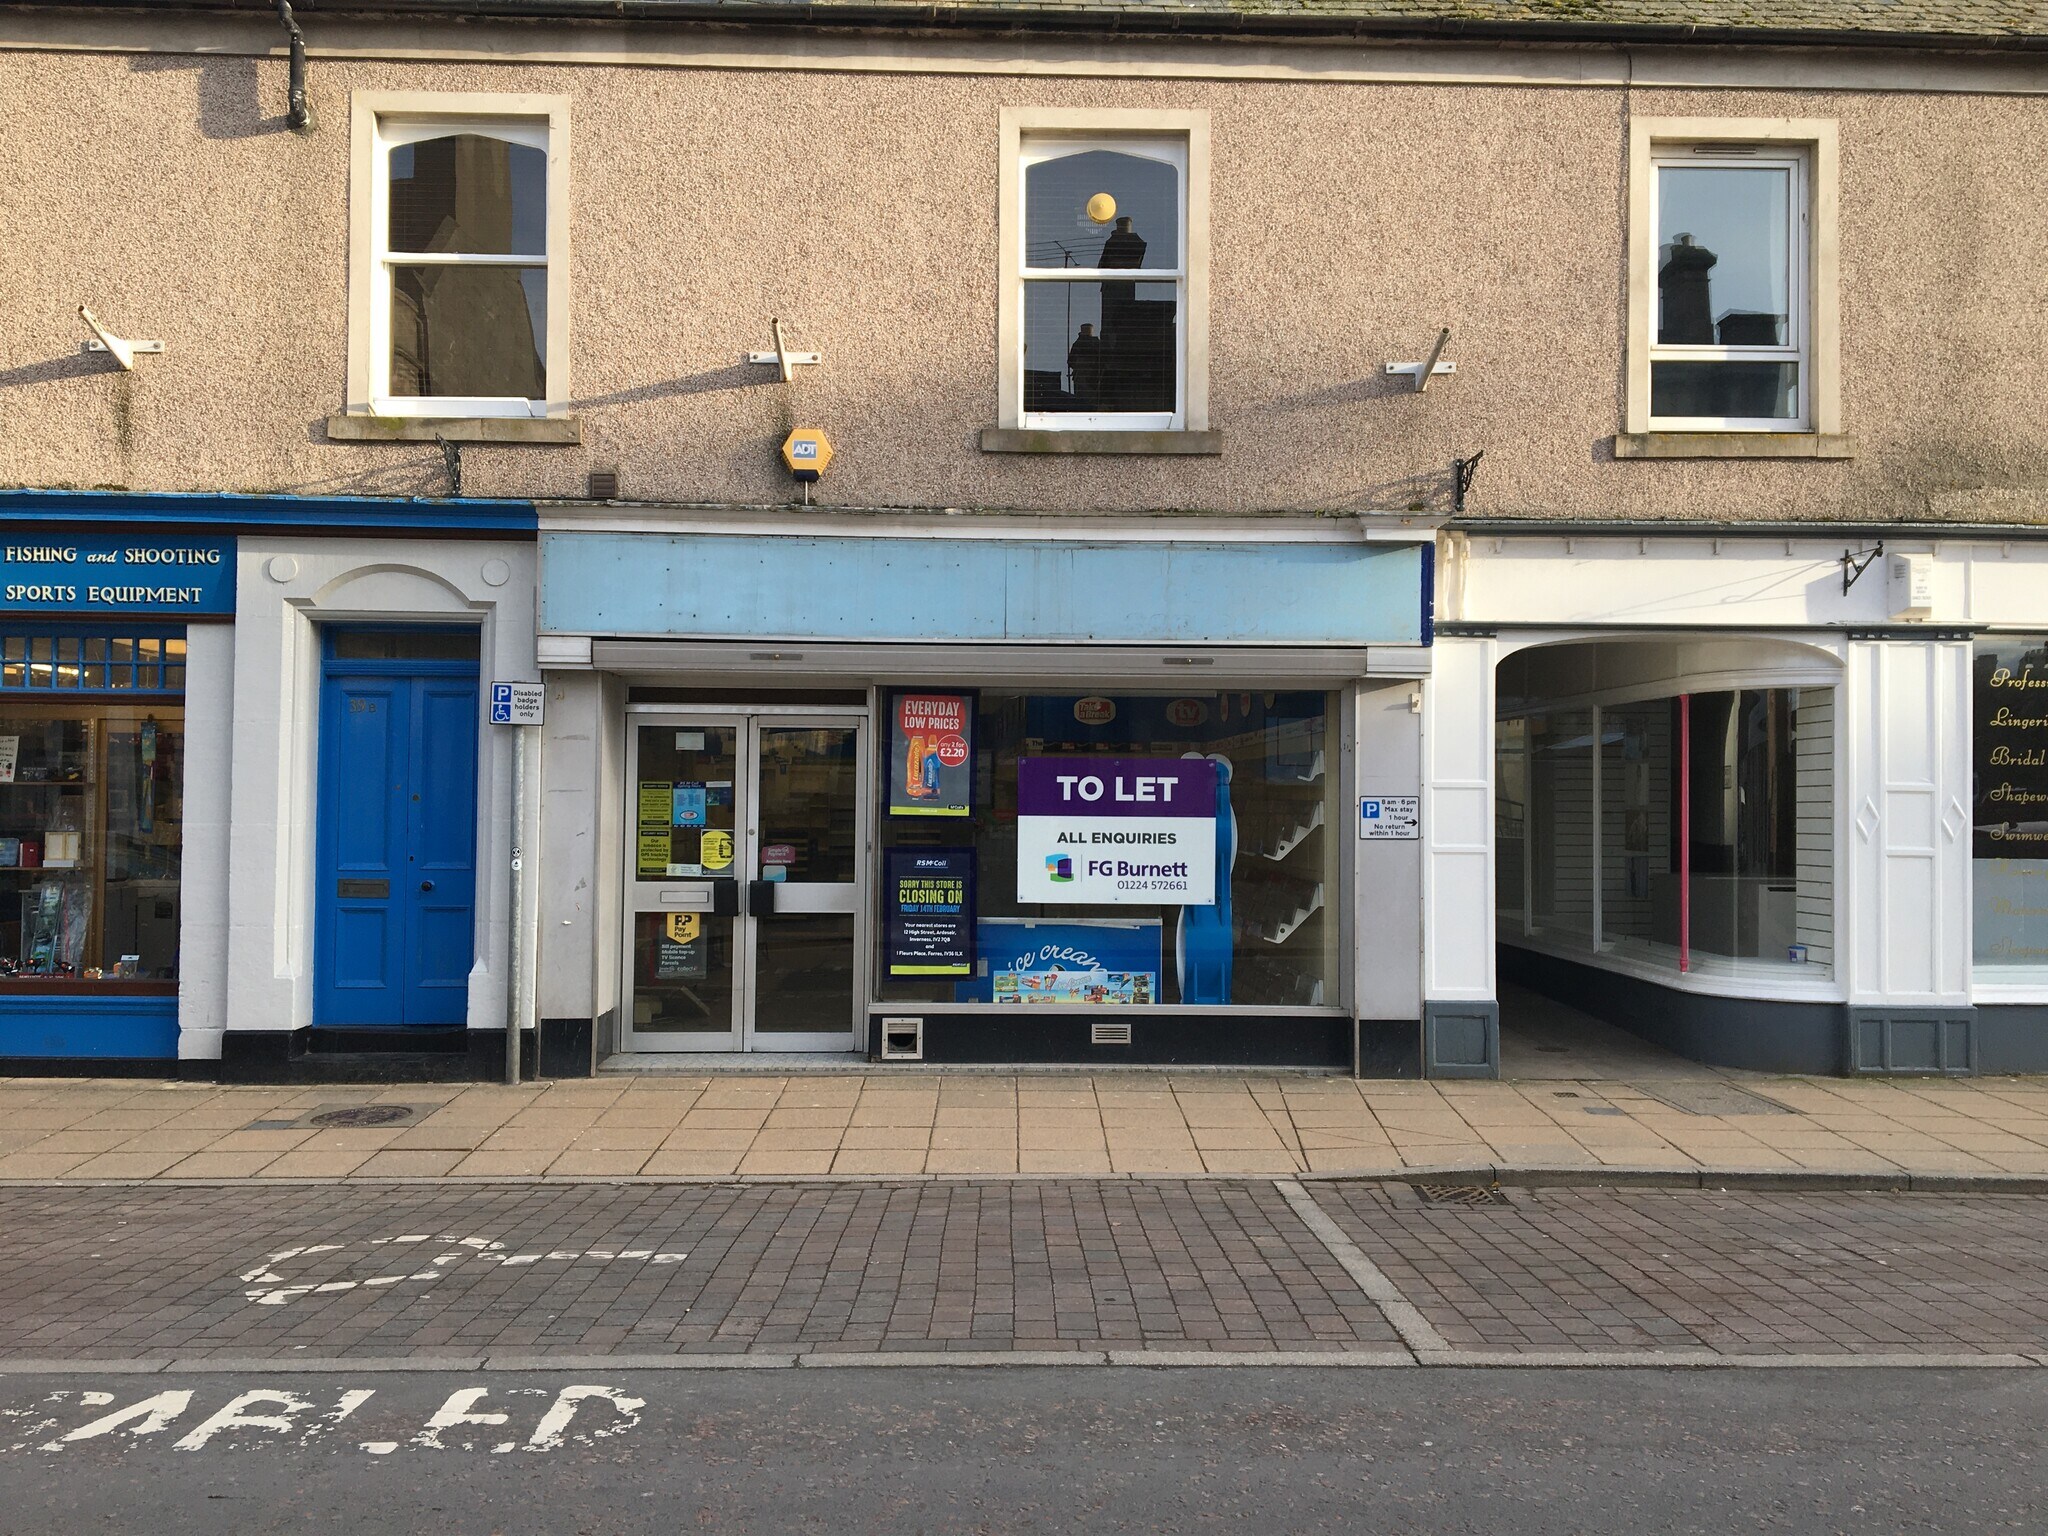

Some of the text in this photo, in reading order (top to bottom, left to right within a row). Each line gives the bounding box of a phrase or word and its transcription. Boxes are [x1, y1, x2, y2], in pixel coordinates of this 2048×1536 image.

[793, 443, 816, 455] ADT
[6, 546, 220, 564] FISHING and SHOOTING
[6, 585, 203, 604] SPORTS EQUIPMENT
[1990, 668, 2048, 690] Profess
[498, 687, 509, 701] P
[905, 700, 960, 716] EVERYDAY
[1086, 711, 1111, 719] Break
[904, 716, 960, 730] LOW PRICES
[940, 748, 965, 758] £2.20
[1990, 746, 2045, 765] Bridal
[1056, 776, 1178, 801] TO LET
[1366, 803, 1378, 817] P
[1057, 832, 1177, 845] ALL ENQUIRIES
[1088, 860, 1188, 877] FG Burnett
[899, 880, 963, 889] SORRY THIS STORE IS
[1117, 880, 1188, 889] 01224 572661
[899, 889, 963, 904] CLOSING ON
[901, 904, 961, 913] FRIDAY 14TH FEBRUARY
[1008, 951, 1036, 972] ice
